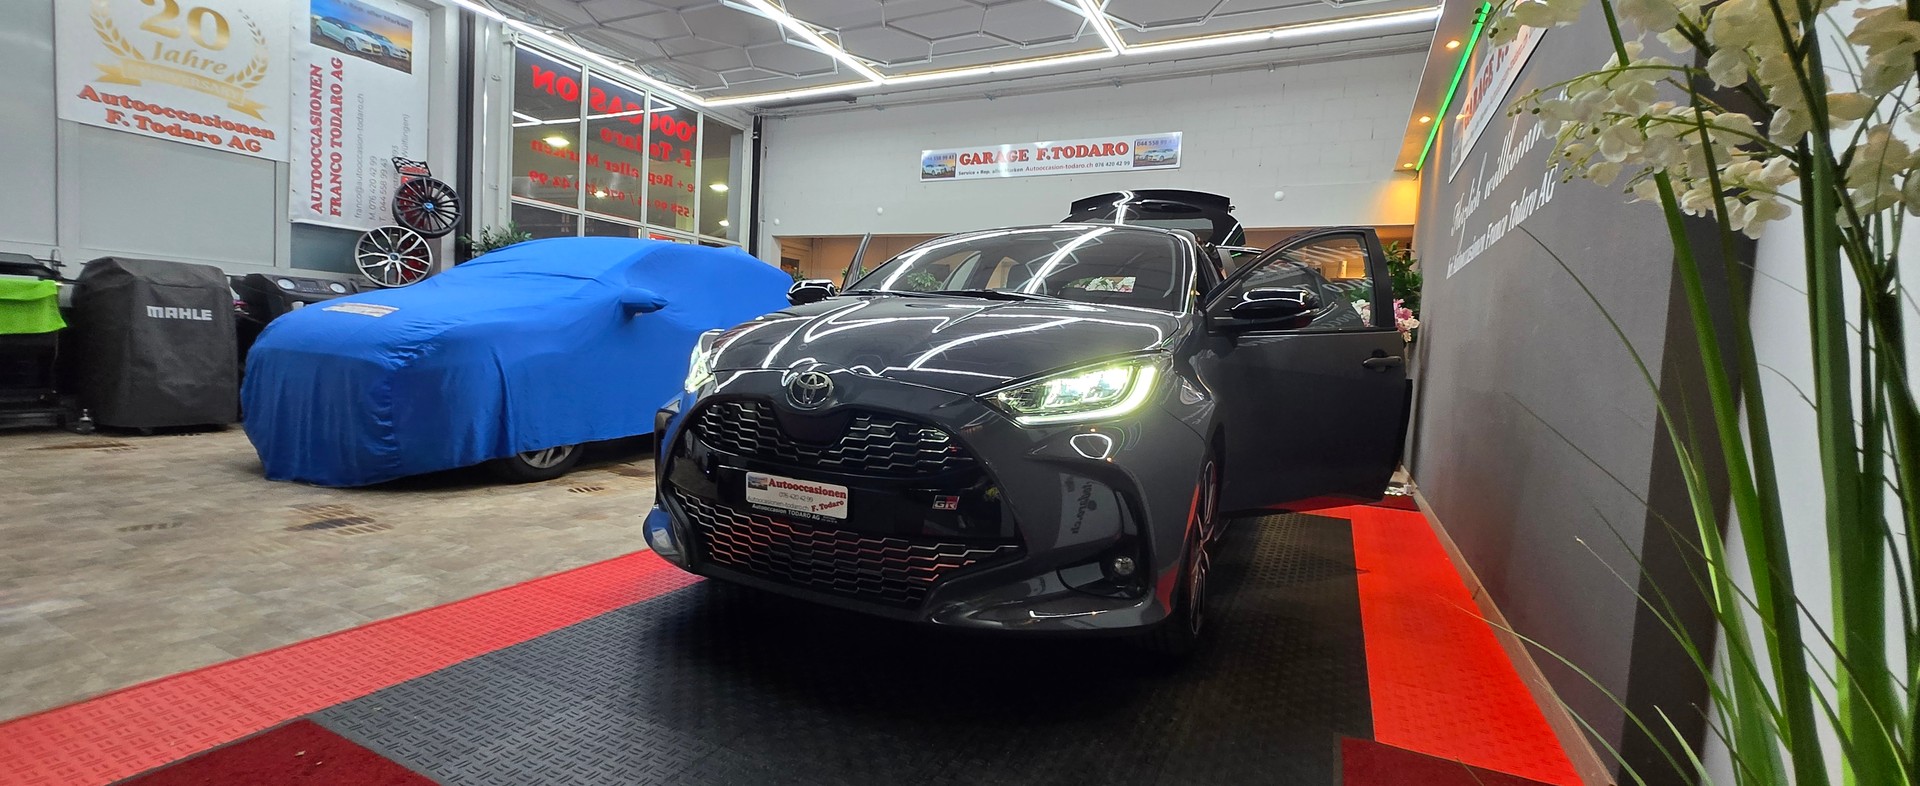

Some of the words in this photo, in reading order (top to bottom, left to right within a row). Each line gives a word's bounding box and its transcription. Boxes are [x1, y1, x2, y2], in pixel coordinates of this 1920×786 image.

[140, 0, 231, 51] 20
[152, 41, 228, 75] Jahre
[330, 57, 343, 82] AG
[76, 84, 276, 140] Autooccasionen
[329, 83, 343, 148] TODARO
[104, 107, 131, 127] F.
[132, 114, 223, 145] Todaro
[226, 134, 263, 152] AG
[309, 64, 323, 214] AUTOOCCASIONEN
[370, 155, 377, 166] 99
[960, 149, 1029, 165] GARAGE
[1025, 162, 1093, 172] Autooccasion-todaro.ch
[330, 152, 343, 217] FRANCO
[369, 179, 377, 194] 420
[1508, 187, 1538, 232] Todaro
[1536, 162, 1559, 211] AG
[146, 305, 213, 321] MAHLE
[769, 478, 846, 499] Autooccasionen
[788, 509, 811, 518] TODARO
[819, 500, 844, 510] Todaro
